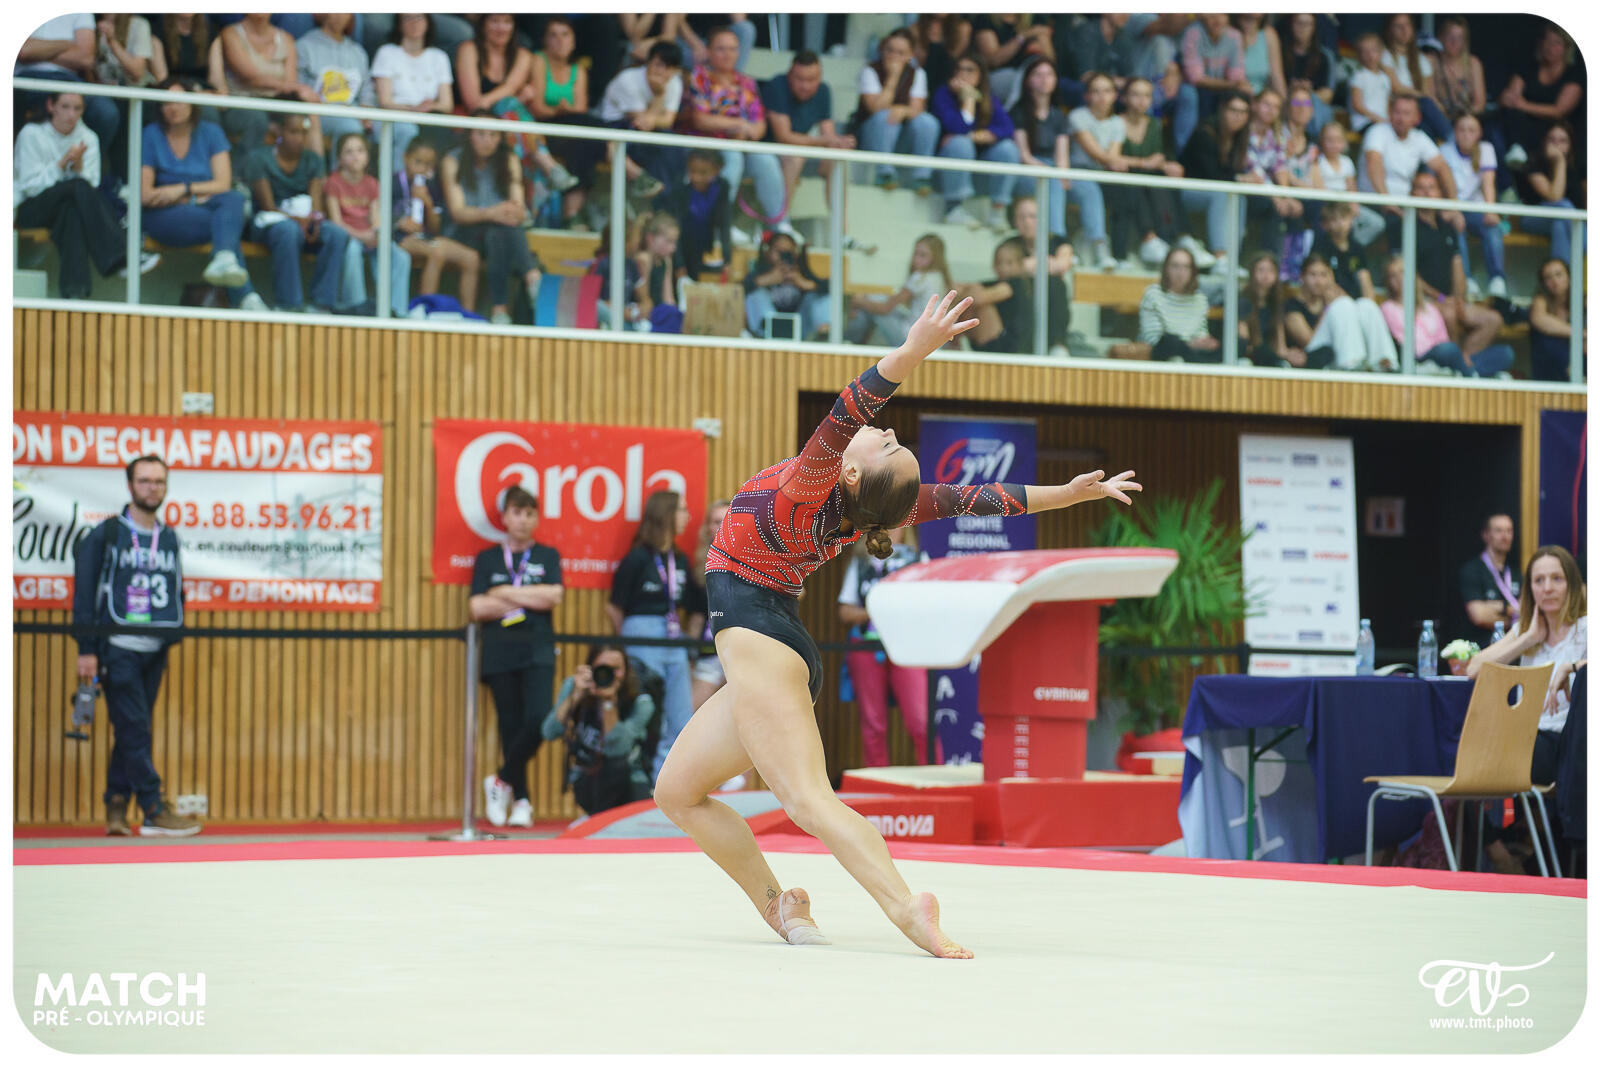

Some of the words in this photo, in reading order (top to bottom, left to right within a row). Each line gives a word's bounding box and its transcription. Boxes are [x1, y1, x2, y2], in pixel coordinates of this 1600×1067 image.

[61, 425, 373, 471] D'ECHAFAUDAGES
[164, 501, 371, 531] 03.88.53.96.21
[229, 582, 375, 605] DEMONTAGE
